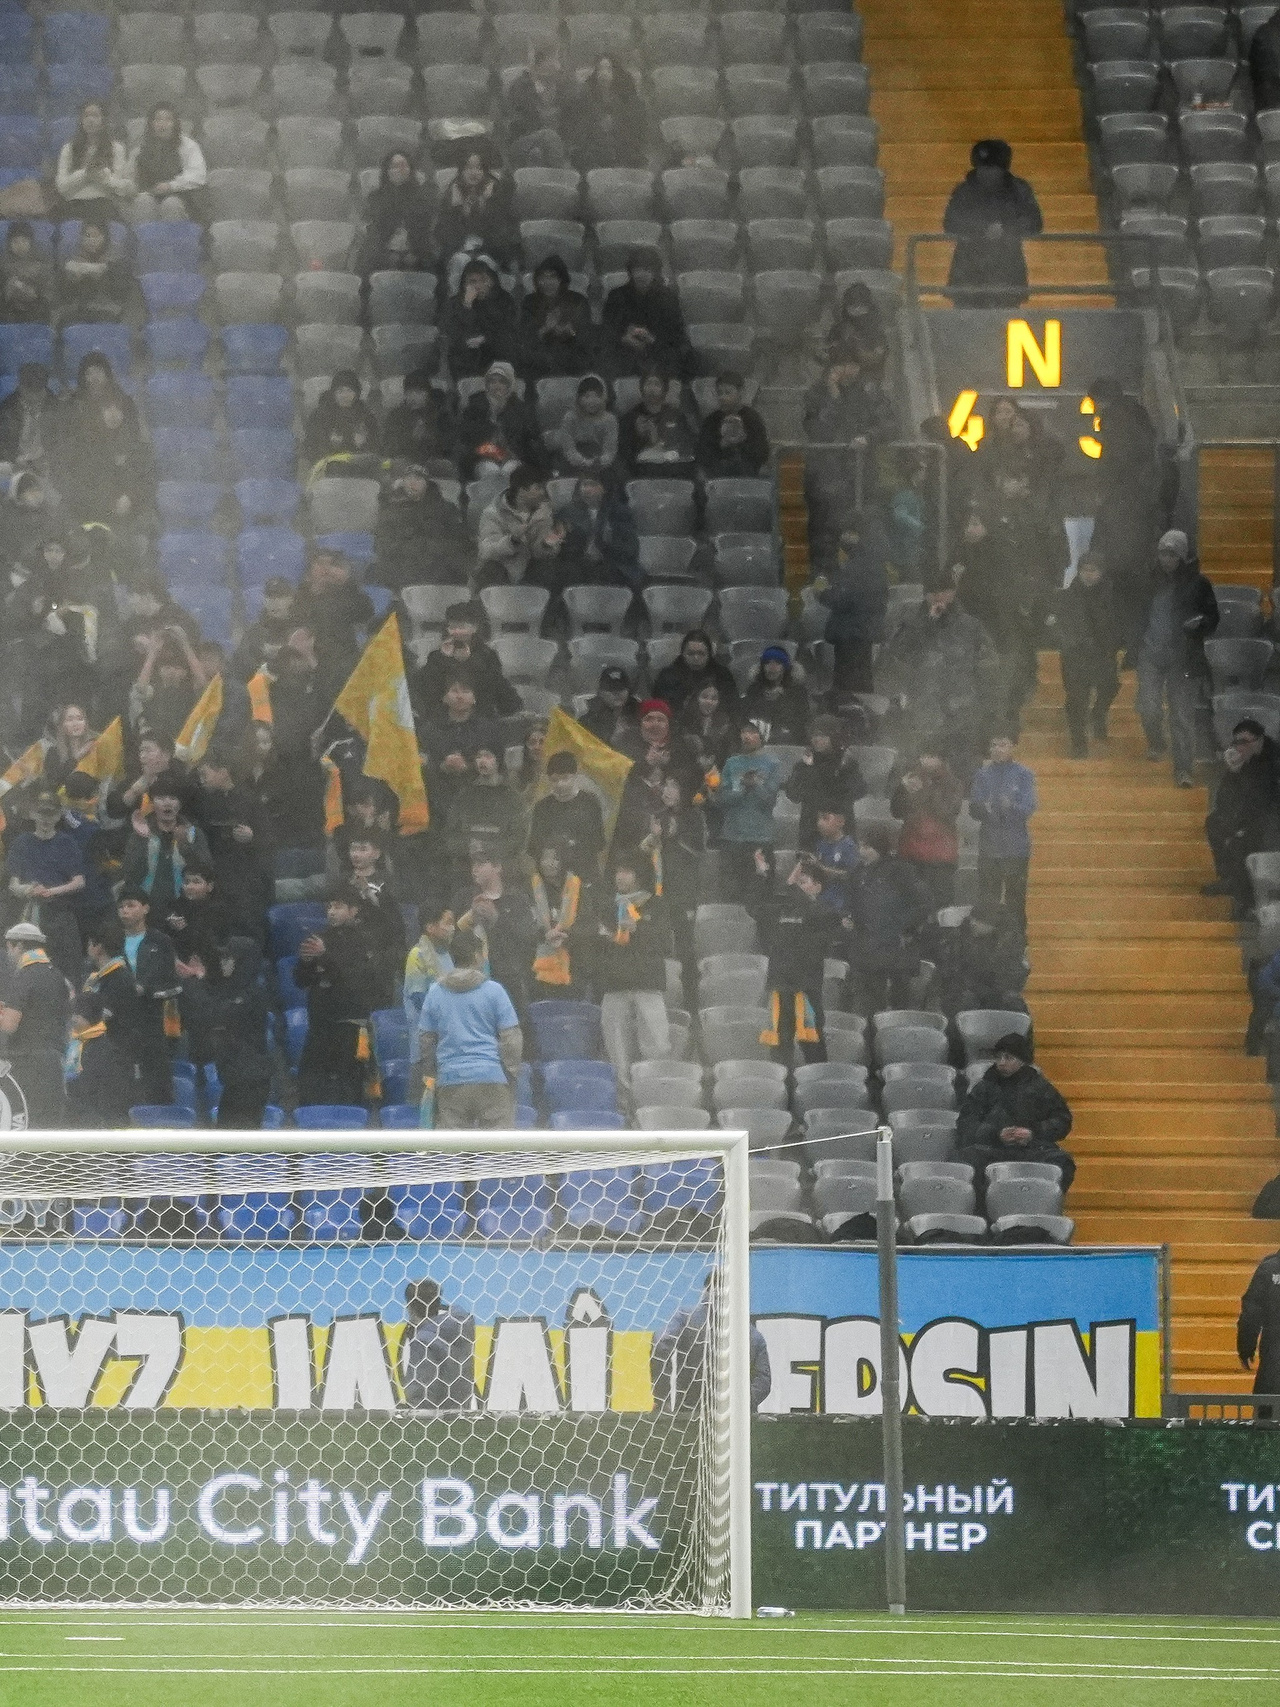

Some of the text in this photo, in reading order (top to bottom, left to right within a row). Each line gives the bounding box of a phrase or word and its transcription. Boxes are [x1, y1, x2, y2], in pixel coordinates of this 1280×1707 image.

[1007, 318, 1061, 388] N
[947, 389, 985, 452] 4
[197, 1469, 391, 1566] City
[422, 1473, 661, 1550] Bank
[795, 1520, 988, 1551] ПАРНЕР
